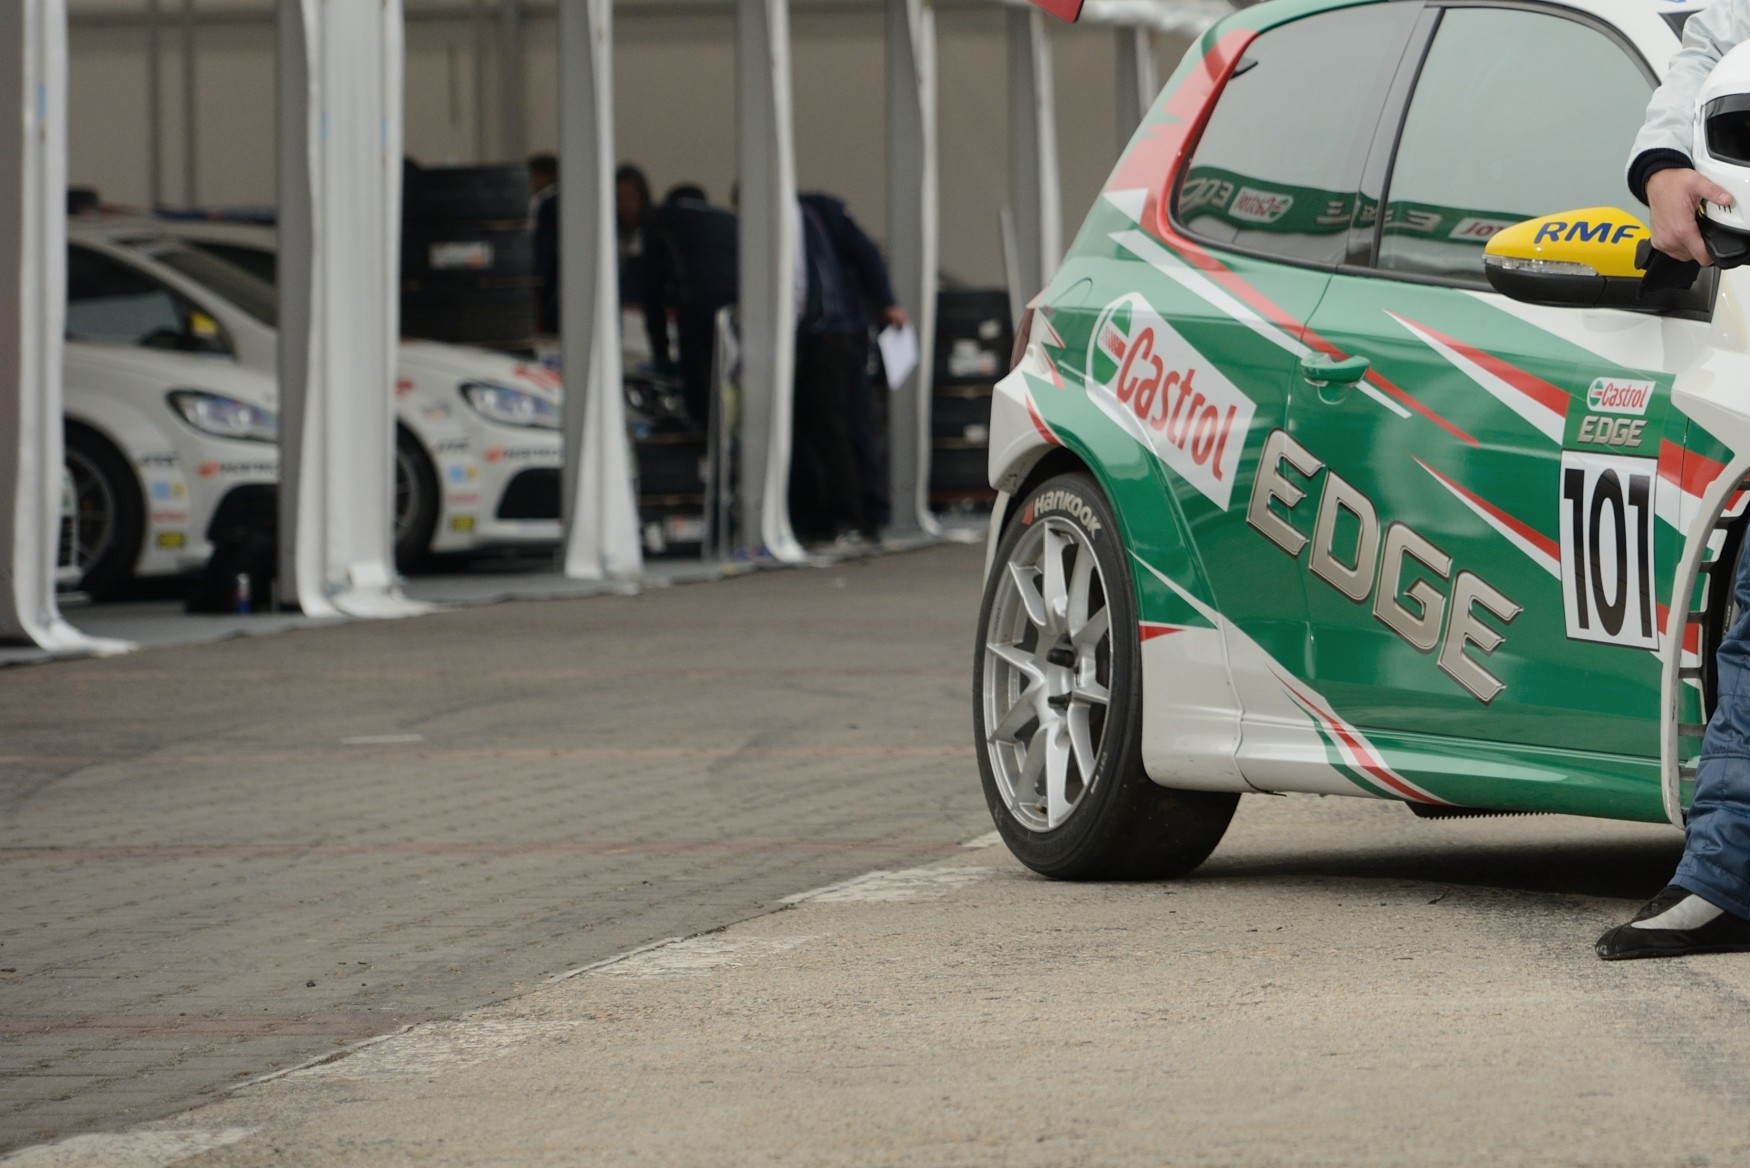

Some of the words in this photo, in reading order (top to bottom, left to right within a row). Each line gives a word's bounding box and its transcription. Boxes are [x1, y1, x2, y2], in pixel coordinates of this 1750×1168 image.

[1534, 221, 1641, 245] RMF
[1116, 326, 1237, 482] Castrol
[1577, 415, 1647, 448] EDGE
[1601, 382, 1649, 408] Castrol
[1246, 428, 1524, 706] EDGE
[1564, 467, 1653, 639] 101
